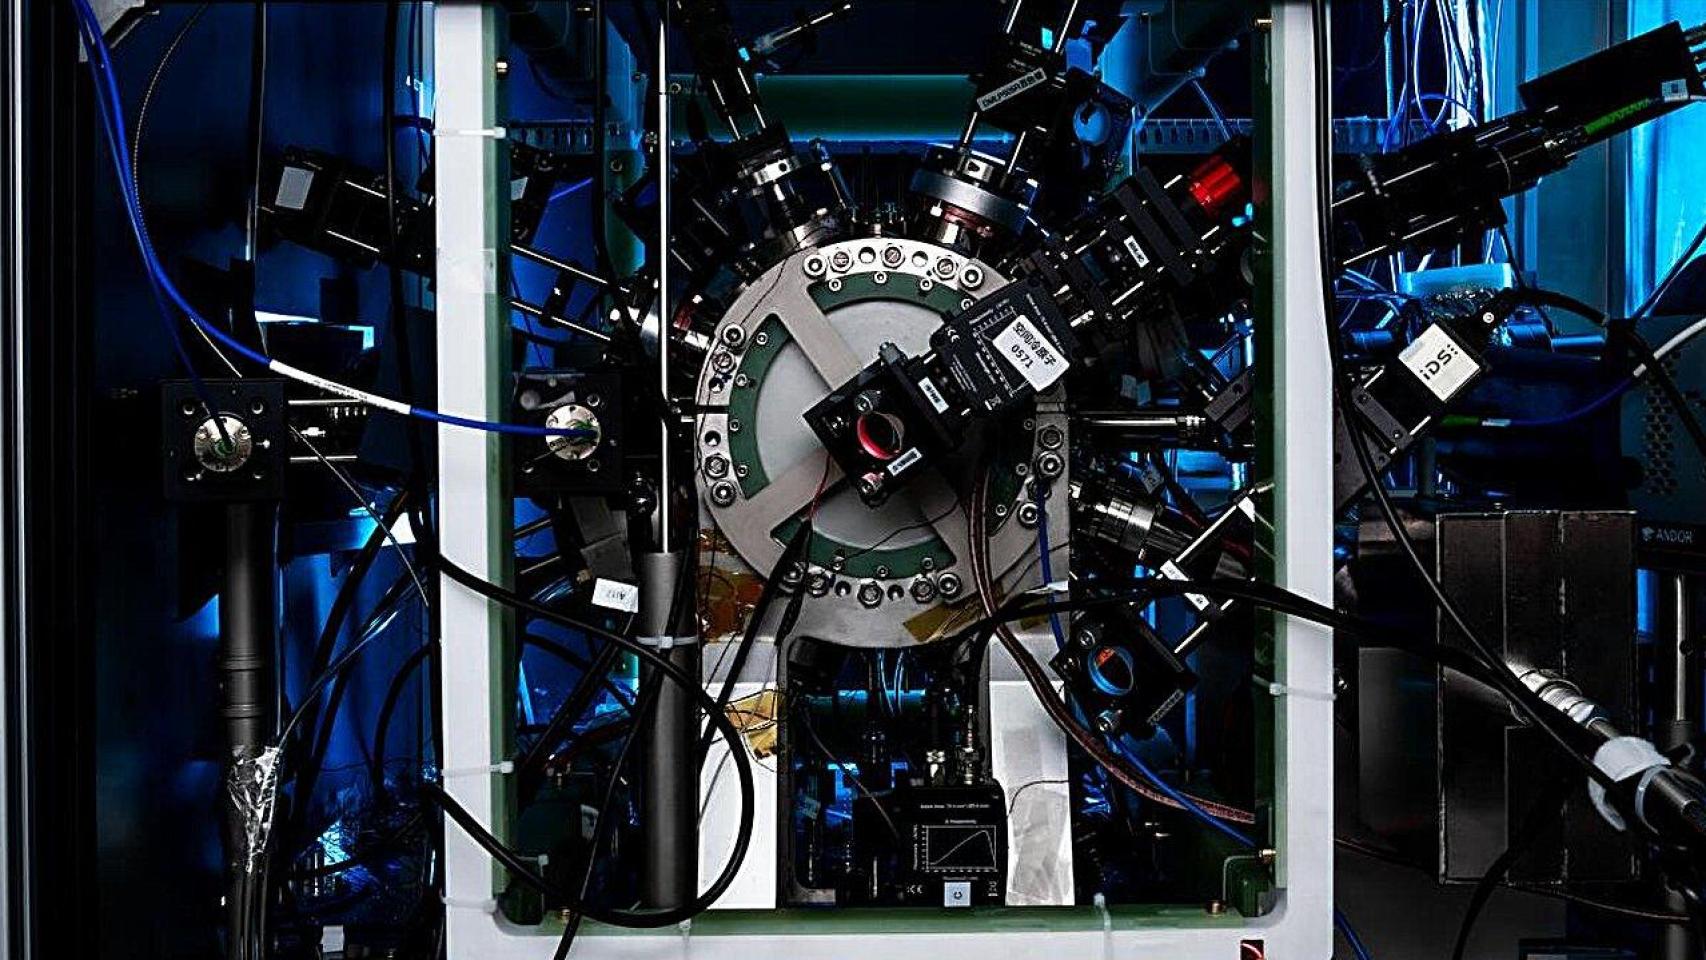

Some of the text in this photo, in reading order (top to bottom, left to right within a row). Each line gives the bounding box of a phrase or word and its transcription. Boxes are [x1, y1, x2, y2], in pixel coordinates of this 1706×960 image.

[1011, 344, 1034, 368] 0571
[1013, 321, 1056, 366] 空间冷原子
